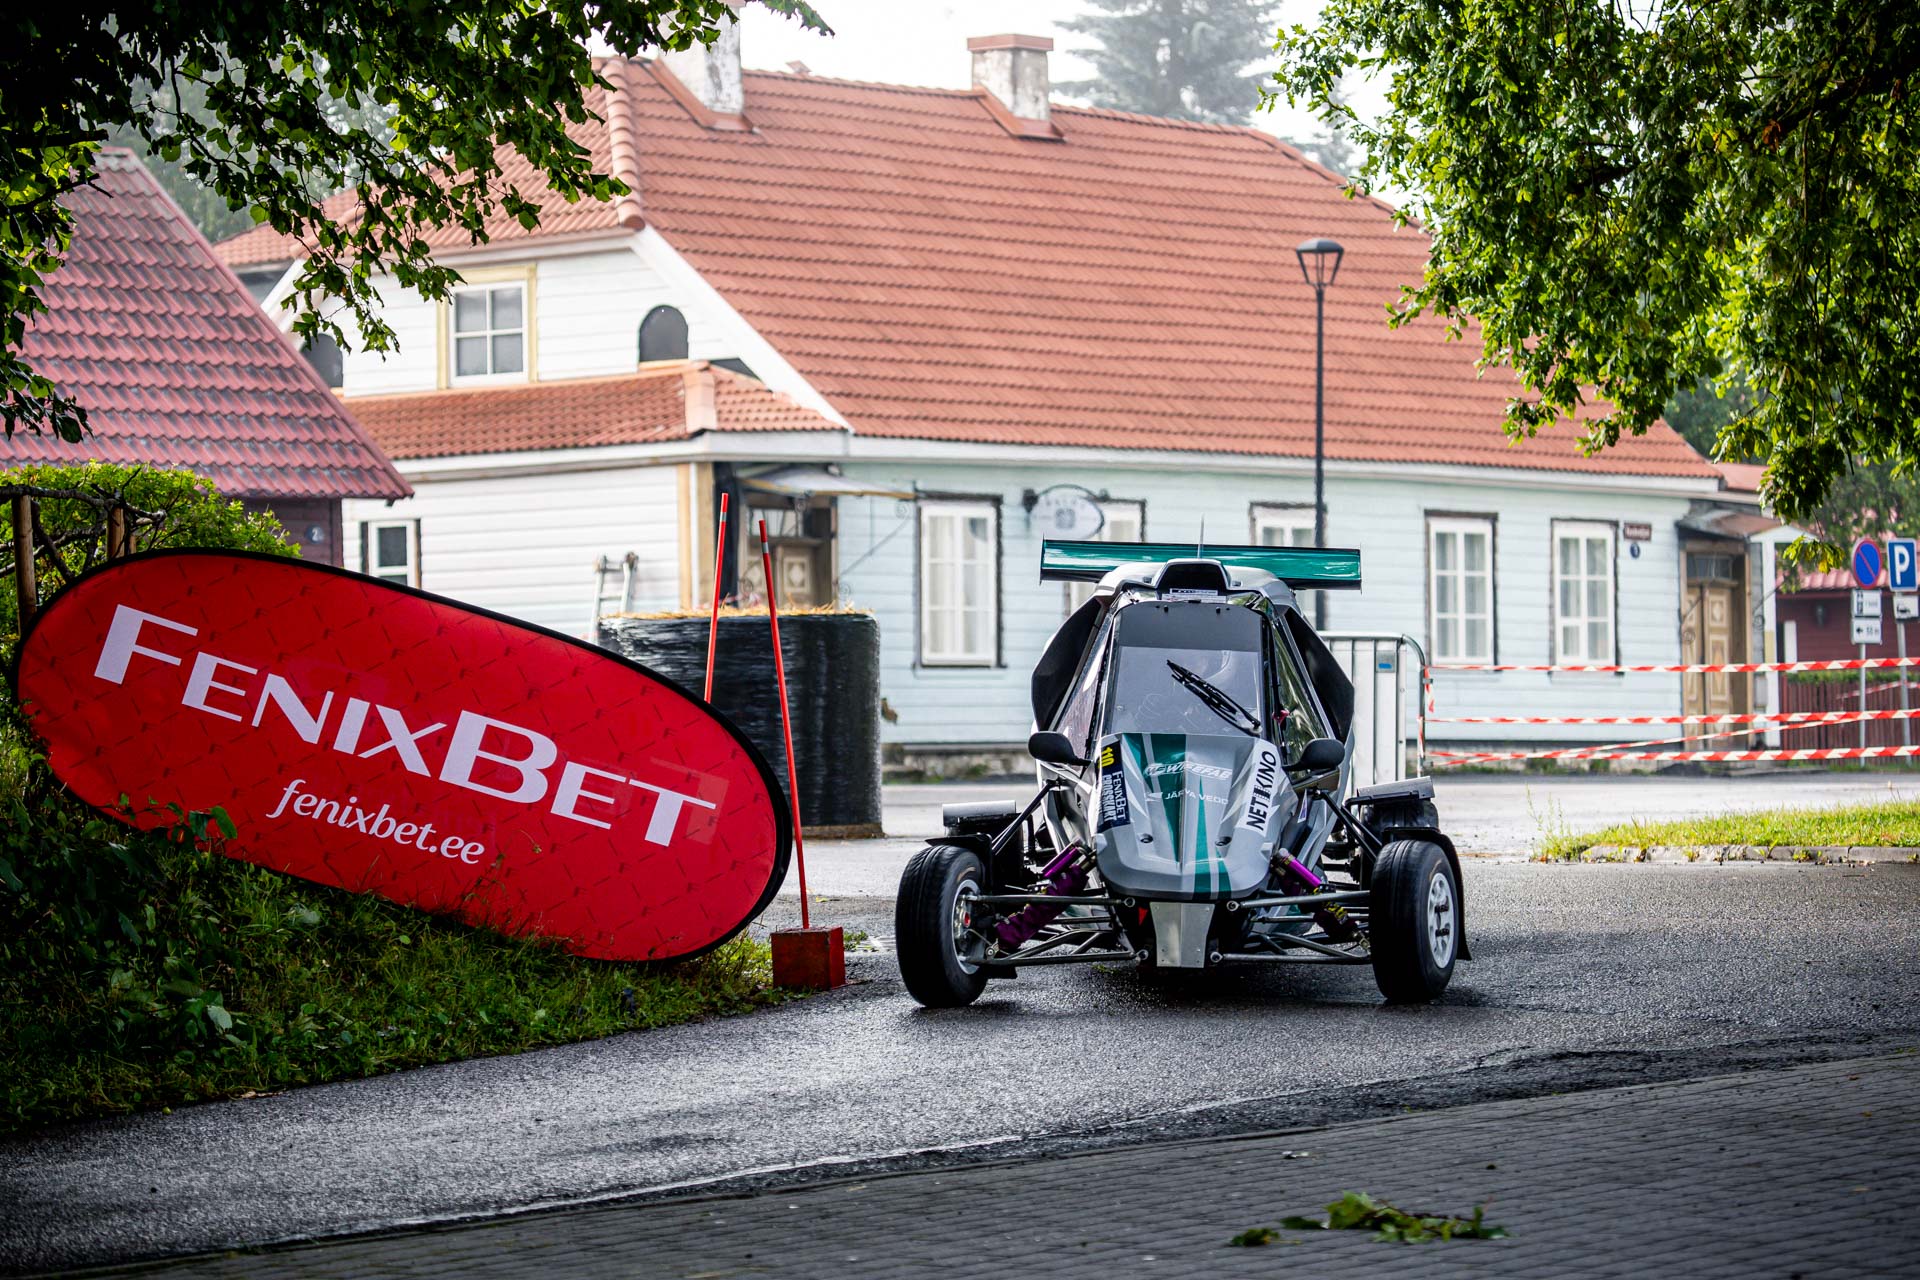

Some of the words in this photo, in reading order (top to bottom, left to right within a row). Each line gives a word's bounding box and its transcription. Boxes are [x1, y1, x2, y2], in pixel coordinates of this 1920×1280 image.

[1894, 544, 1910, 585] P
[1098, 747, 1115, 768] 110
[1102, 774, 1118, 821] CROSSKART
[266, 778, 485, 865] fenixbet.ee
